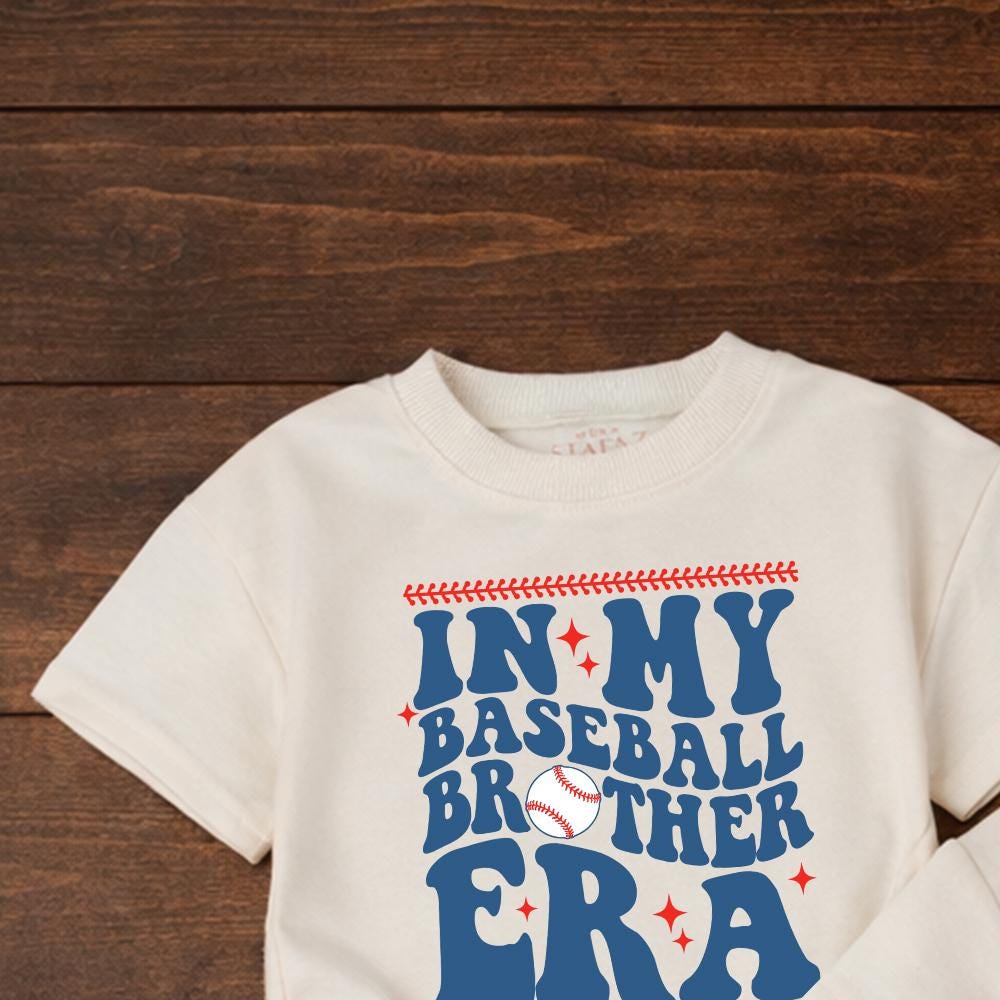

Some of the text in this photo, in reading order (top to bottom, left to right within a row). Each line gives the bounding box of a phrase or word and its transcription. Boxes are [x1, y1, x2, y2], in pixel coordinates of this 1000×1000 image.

[413, 588, 795, 719] IN MY
[417, 697, 804, 791] BASEBALL
